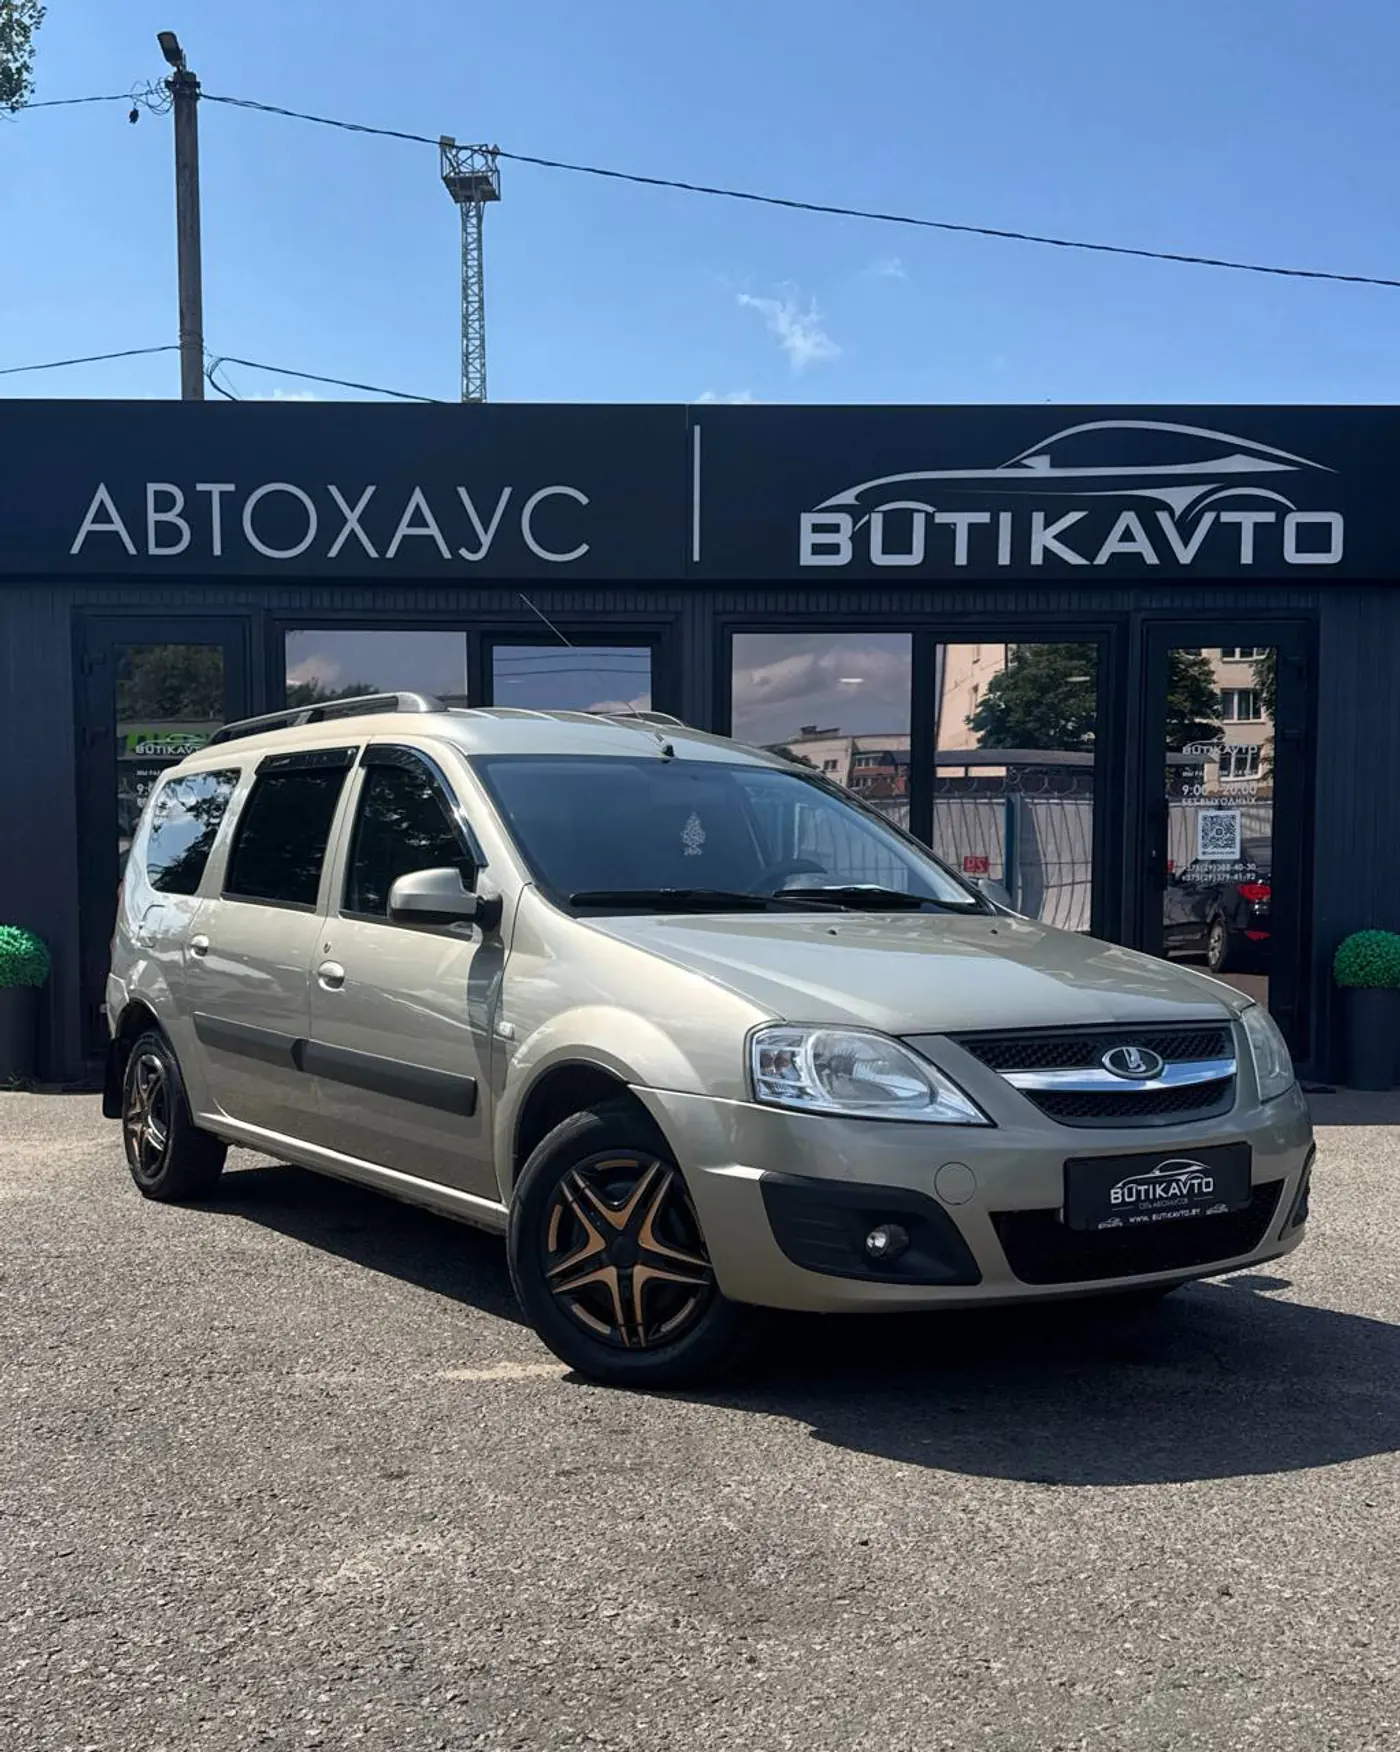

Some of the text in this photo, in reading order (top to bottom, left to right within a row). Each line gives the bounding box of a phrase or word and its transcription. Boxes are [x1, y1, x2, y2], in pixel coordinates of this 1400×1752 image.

[69, 481, 590, 562] АВТОХАУС
[799, 510, 1345, 566] BUTIKAVTO
[1110, 1178, 1214, 1204] BUTIKAVTO
